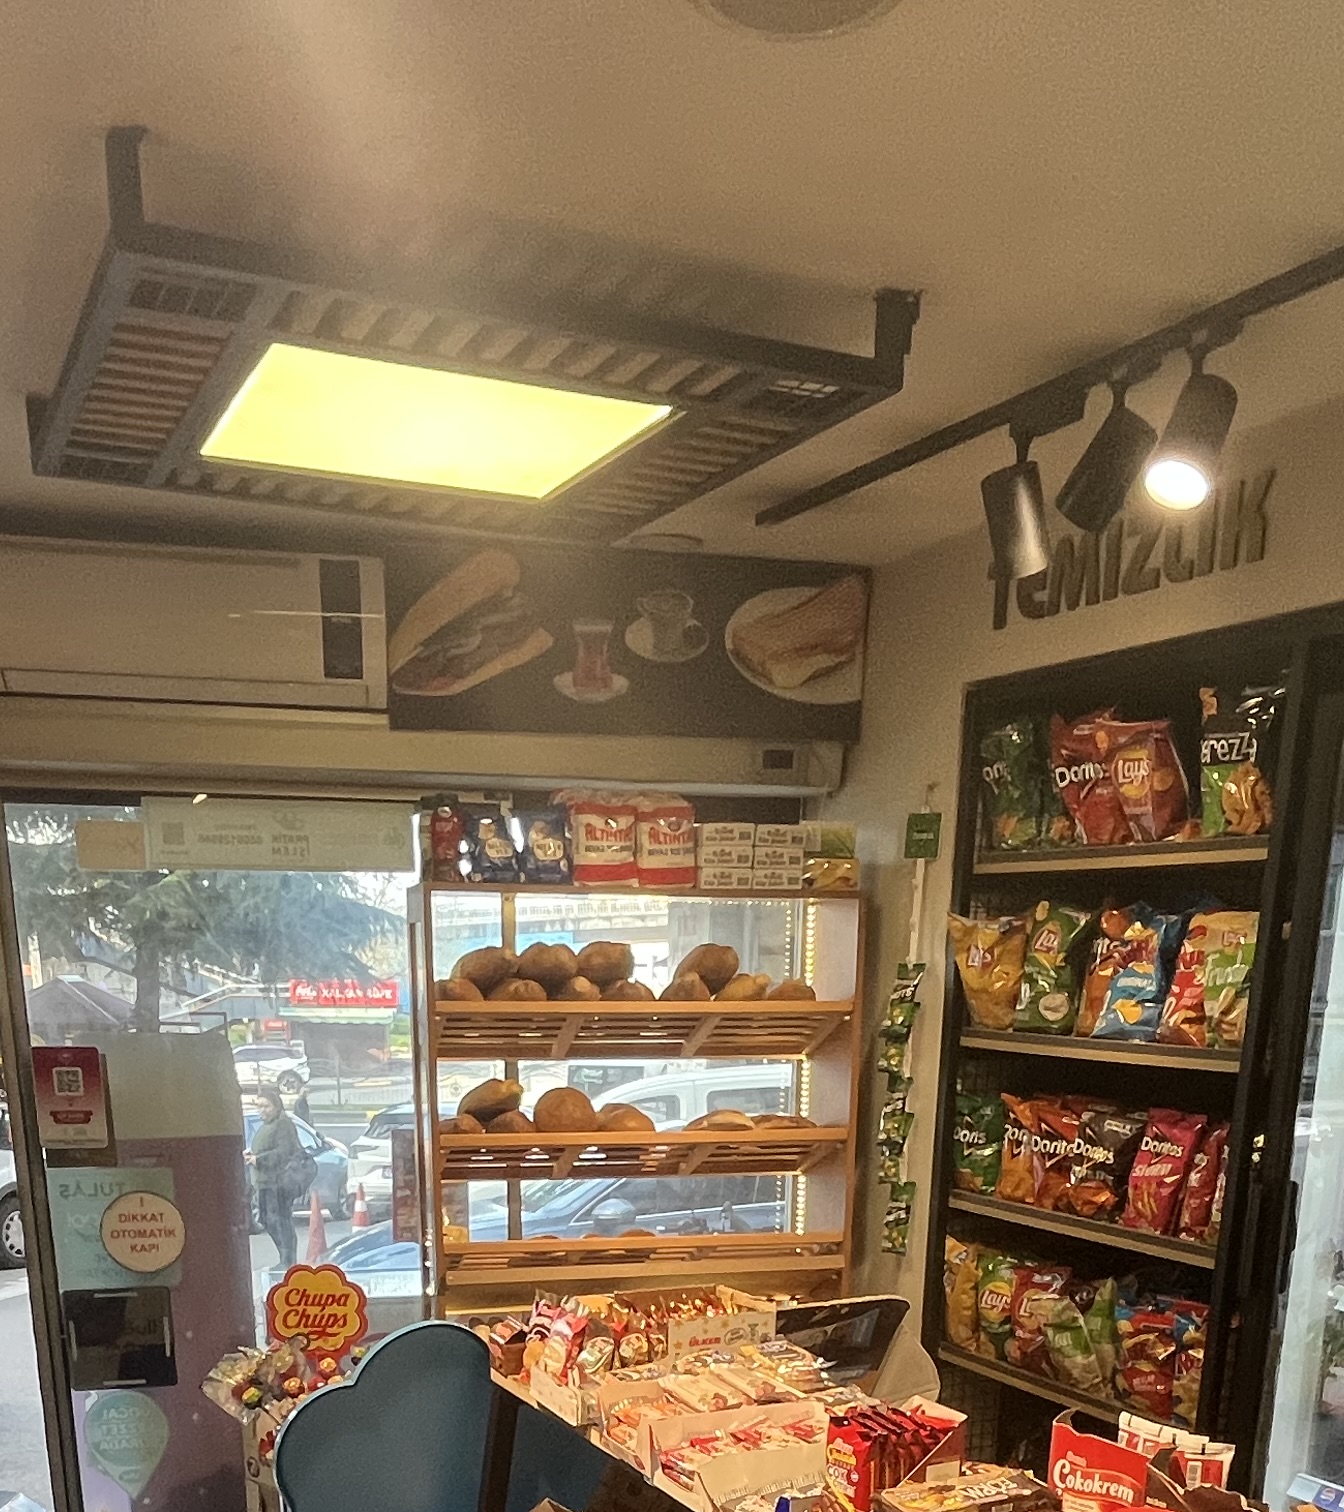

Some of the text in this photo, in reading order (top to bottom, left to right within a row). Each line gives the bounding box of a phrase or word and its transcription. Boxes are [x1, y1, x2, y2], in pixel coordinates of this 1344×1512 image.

[1141, 1135, 1184, 1159] Doritos
[118, 1211, 165, 1224] DİKKAT
[110, 1226, 177, 1240] OTOMATİK
[130, 1243, 161, 1254] KAPI
[284, 1288, 351, 1309] Chupa
